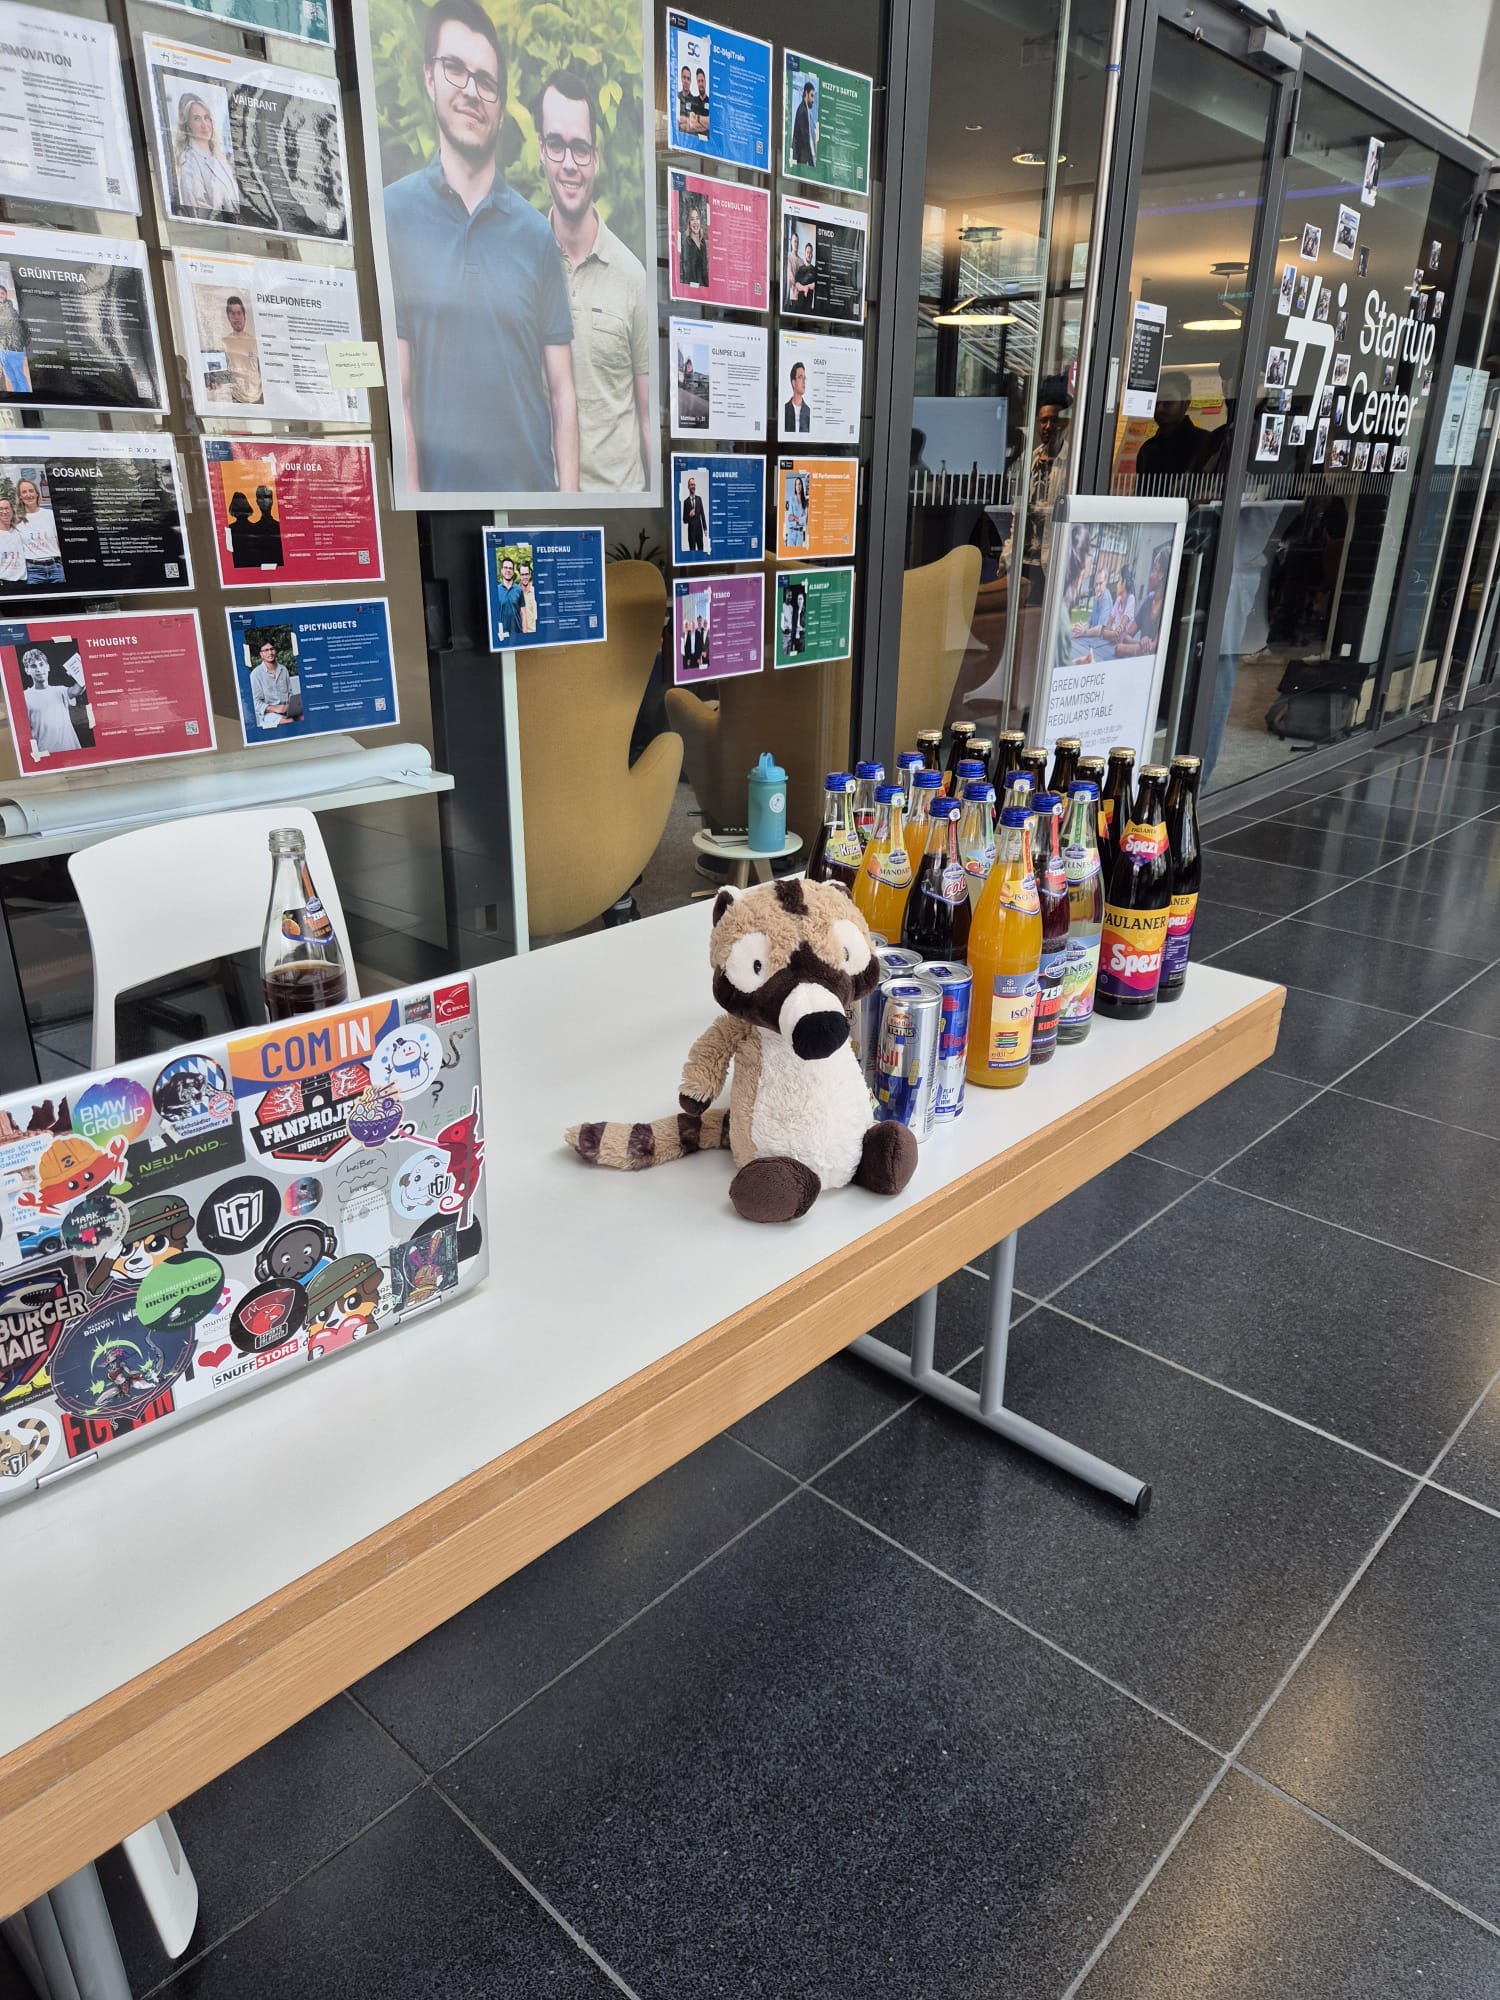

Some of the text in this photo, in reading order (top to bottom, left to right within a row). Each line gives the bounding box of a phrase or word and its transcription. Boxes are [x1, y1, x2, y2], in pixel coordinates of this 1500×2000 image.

[0, 42, 72, 68] RMOVATION
[232, 94, 278, 112] VAIBRANT
[721, 200, 752, 213] CONSULTING
[18, 266, 87, 284] GRÜNTERRA
[256, 293, 322, 309] PIXELPIONEERS
[1359, 289, 1436, 378] Startup
[712, 347, 733, 357] GLIMPSE
[1346, 371, 1418, 438] Center
[52, 467, 104, 478] COSANEA
[280, 462, 322, 472] YOUR IDEA
[536, 545, 571, 554] FELDSCHAU
[298, 620, 358, 633] SPICYNUGGETS
[86, 636, 138, 648] THOUGHTS
[1052, 672, 1106, 693] GREEN OFFICE
[1049, 690, 1101, 711] STAMMTISCH
[1091, 704, 1114, 719] TABLE
[1125, 834, 1159, 855] Spezi
[1110, 943, 1163, 978] Spezi
[888, 1025, 914, 1037] TETRIS
[79, 1095, 127, 1122] BMW
[82, 1106, 146, 1137] GROUP
[139, 1140, 220, 1174] NEULAND
[71, 1210, 99, 1226] MARK
[145, 1290, 180, 1309] meine
[0, 1293, 86, 1343] BURGER
